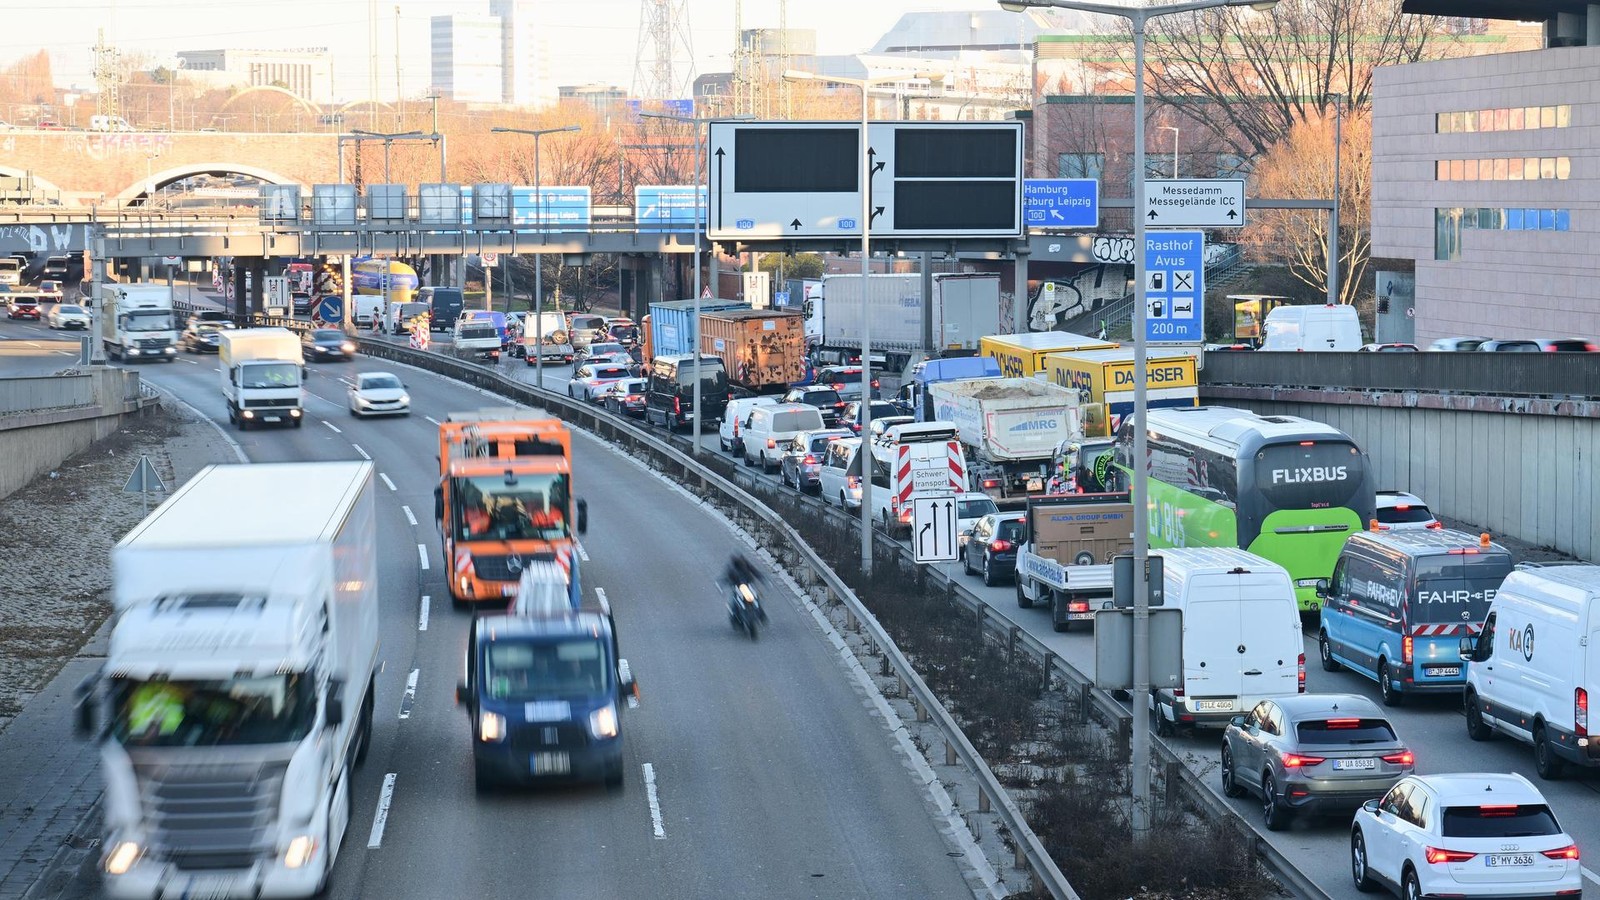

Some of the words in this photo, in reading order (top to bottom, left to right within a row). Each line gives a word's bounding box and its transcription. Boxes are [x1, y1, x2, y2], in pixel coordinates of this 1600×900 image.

[1024, 185, 1068, 195] Hamburg
[1163, 186, 1222, 195] Messedamm
[1058, 197, 1091, 207] Leipzig
[1149, 197, 1216, 207] Messegelände
[1220, 196, 1235, 205] ICC
[739, 220, 752, 229] 100
[841, 220, 853, 228] 100
[1146, 239, 1193, 251] Rasthof
[1155, 255, 1185, 266] Avus
[1152, 323, 1174, 334] 200
[1176, 325, 1187, 334] m
[1115, 367, 1184, 385] DAHSER
[1028, 420, 1057, 429] MRG
[916, 471, 945, 479] Schwer-
[915, 480, 948, 488] transport
[1076, 513, 1100, 521] GROUP
[1501, 856, 1512, 865] MY
[1513, 856, 1533, 864] 3636
